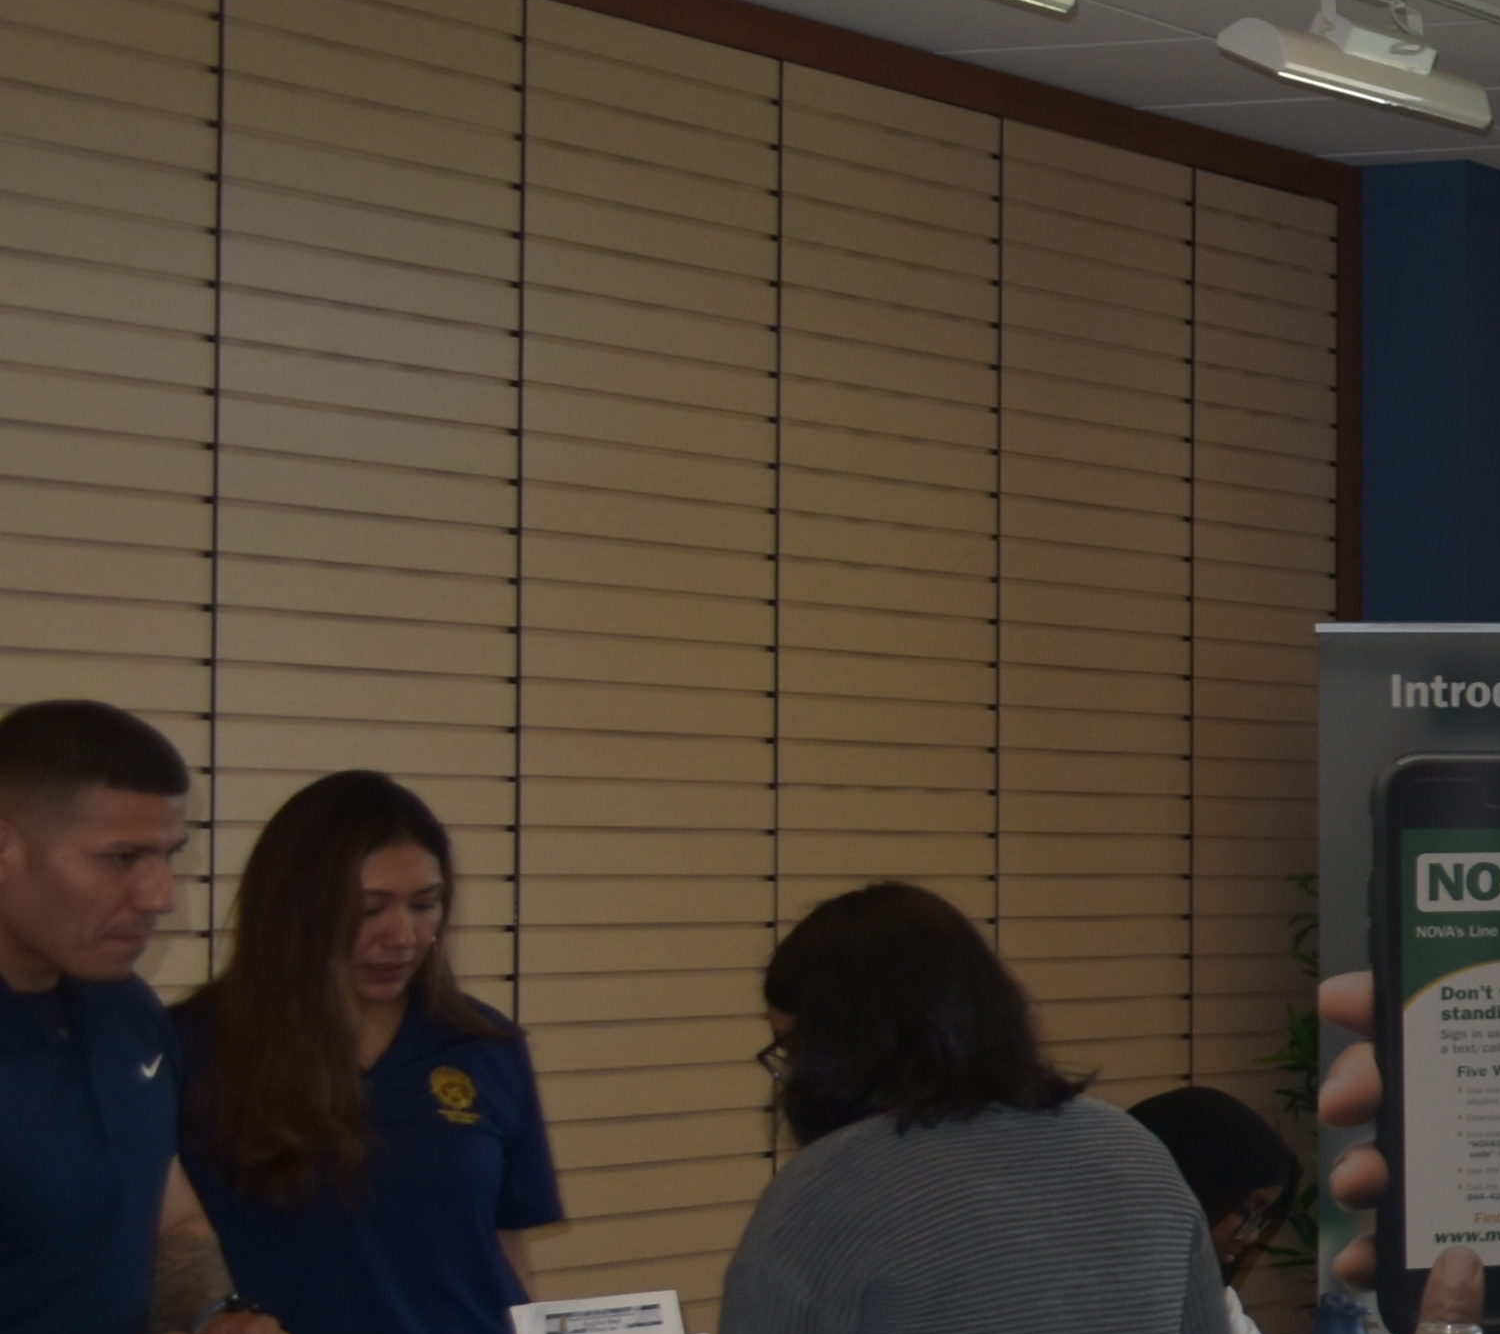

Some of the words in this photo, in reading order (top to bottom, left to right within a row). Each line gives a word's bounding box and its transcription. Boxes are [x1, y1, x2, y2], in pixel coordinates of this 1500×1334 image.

[1416, 926, 1464, 938] NOVA's
[1469, 924, 1499, 937] Line
[1441, 985, 1493, 1001] Don't
[1441, 1029, 1469, 1042] Sign
[1471, 1028, 1484, 1040] in
[1457, 1065, 1487, 1077] Five
